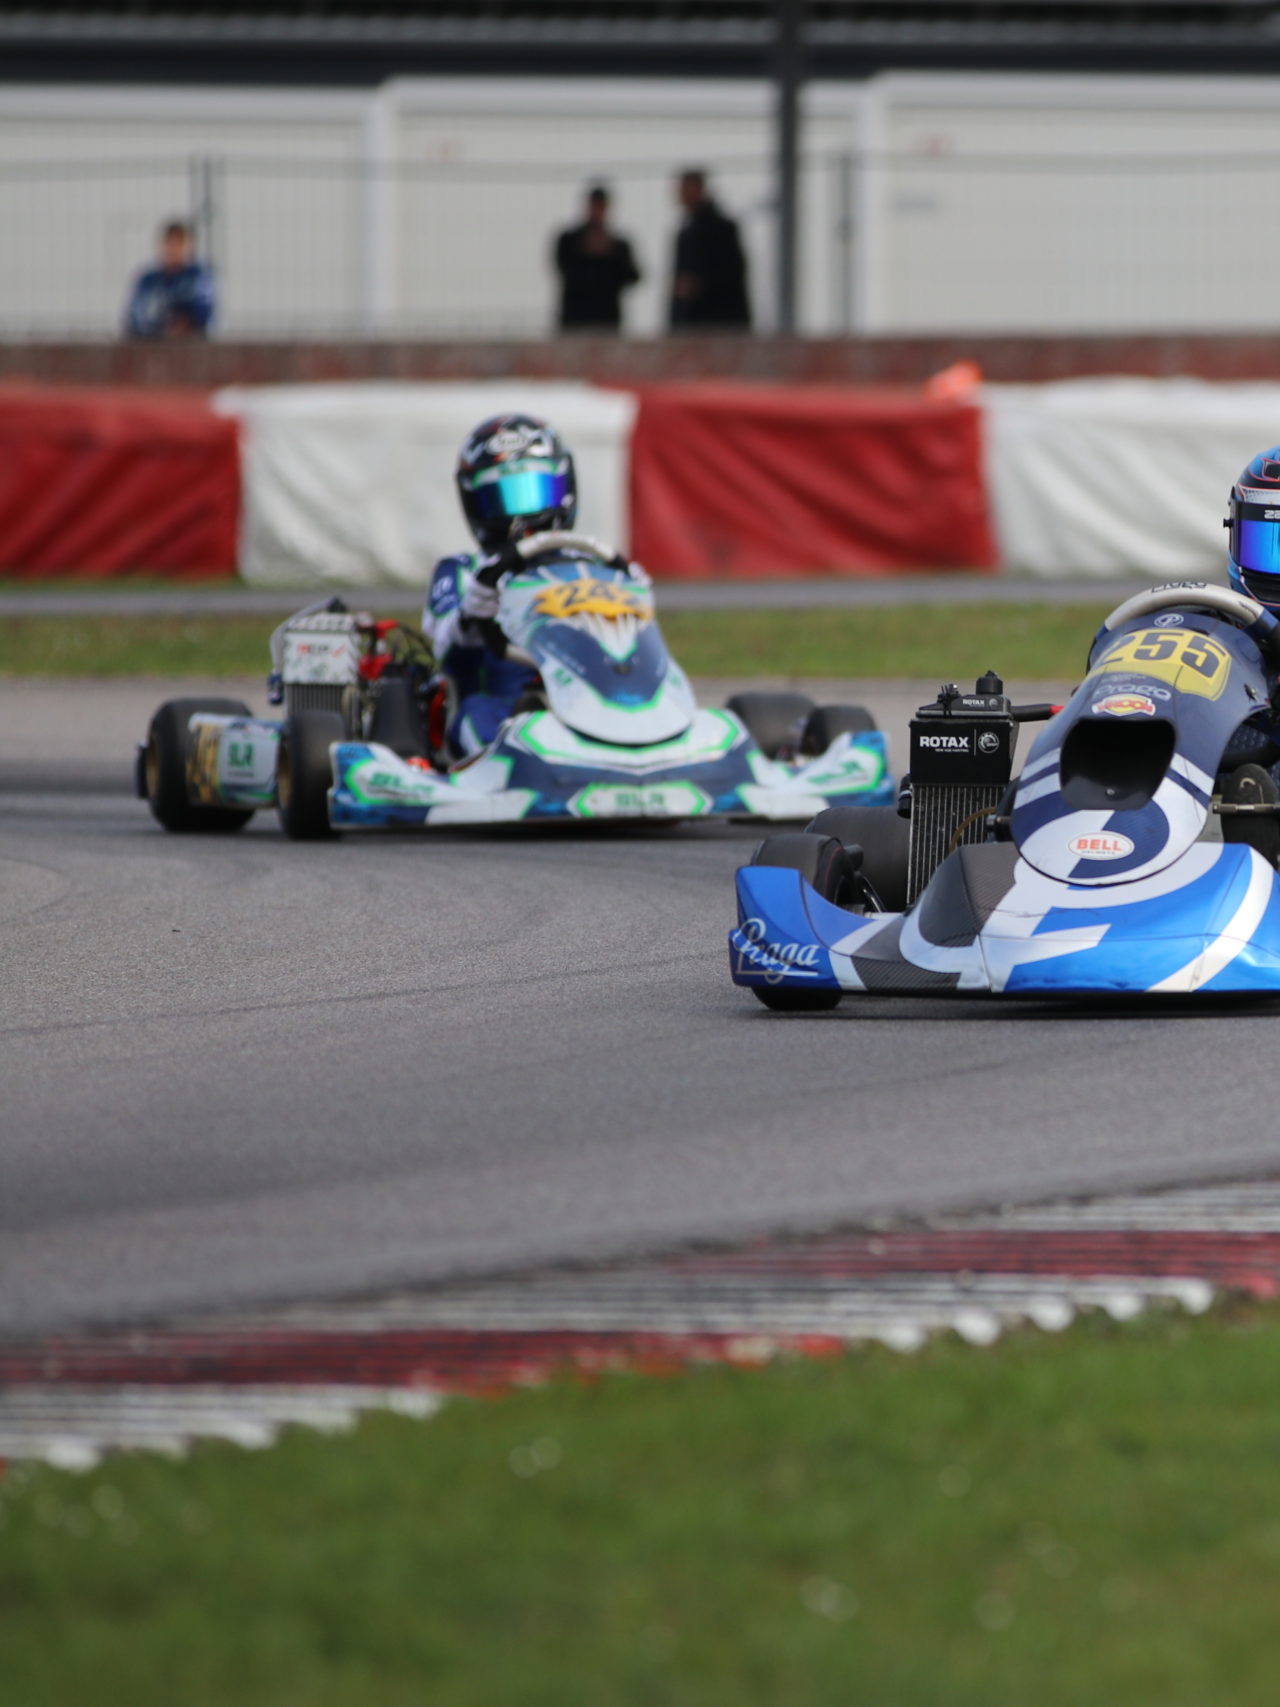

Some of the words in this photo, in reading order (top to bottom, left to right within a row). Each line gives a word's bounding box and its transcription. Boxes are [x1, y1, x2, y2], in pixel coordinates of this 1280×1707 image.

[1102, 632, 1227, 679] 255
[919, 736, 969, 748] ROTAX
[1076, 838, 1123, 852] BELL
[732, 918, 820, 985] Praga
